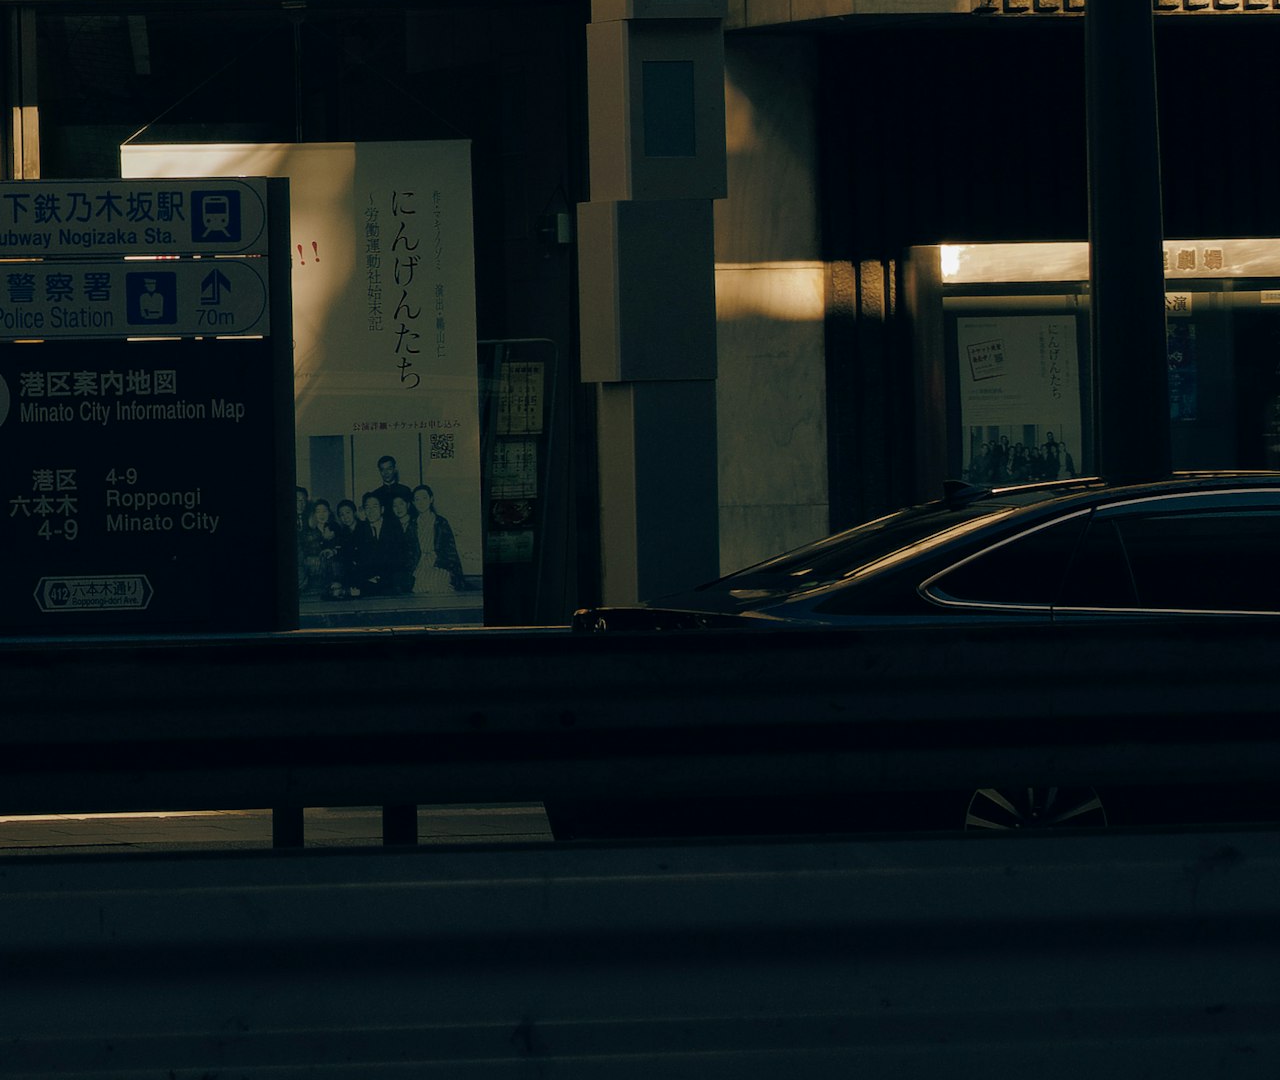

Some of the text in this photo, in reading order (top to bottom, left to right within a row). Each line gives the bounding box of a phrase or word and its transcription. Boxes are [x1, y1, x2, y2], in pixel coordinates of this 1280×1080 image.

[58, 228, 137, 248] Nogizaka
[144, 227, 177, 245] Sta.
[391, 189, 422, 390] にんげんたち
[50, 306, 114, 329] Station
[195, 309, 235, 326] 70m
[19, 369, 177, 397] 港区案内地図
[19, 398, 246, 426] Minato City Information Map
[32, 469, 78, 493] 港区
[105, 467, 138, 485] 4-9
[9, 495, 78, 518] 六本木
[105, 487, 202, 511] Roppongi
[37, 520, 79, 541] 4-9
[105, 512, 220, 534] Minato City
[51, 580, 139, 601] 412 六本木通り
